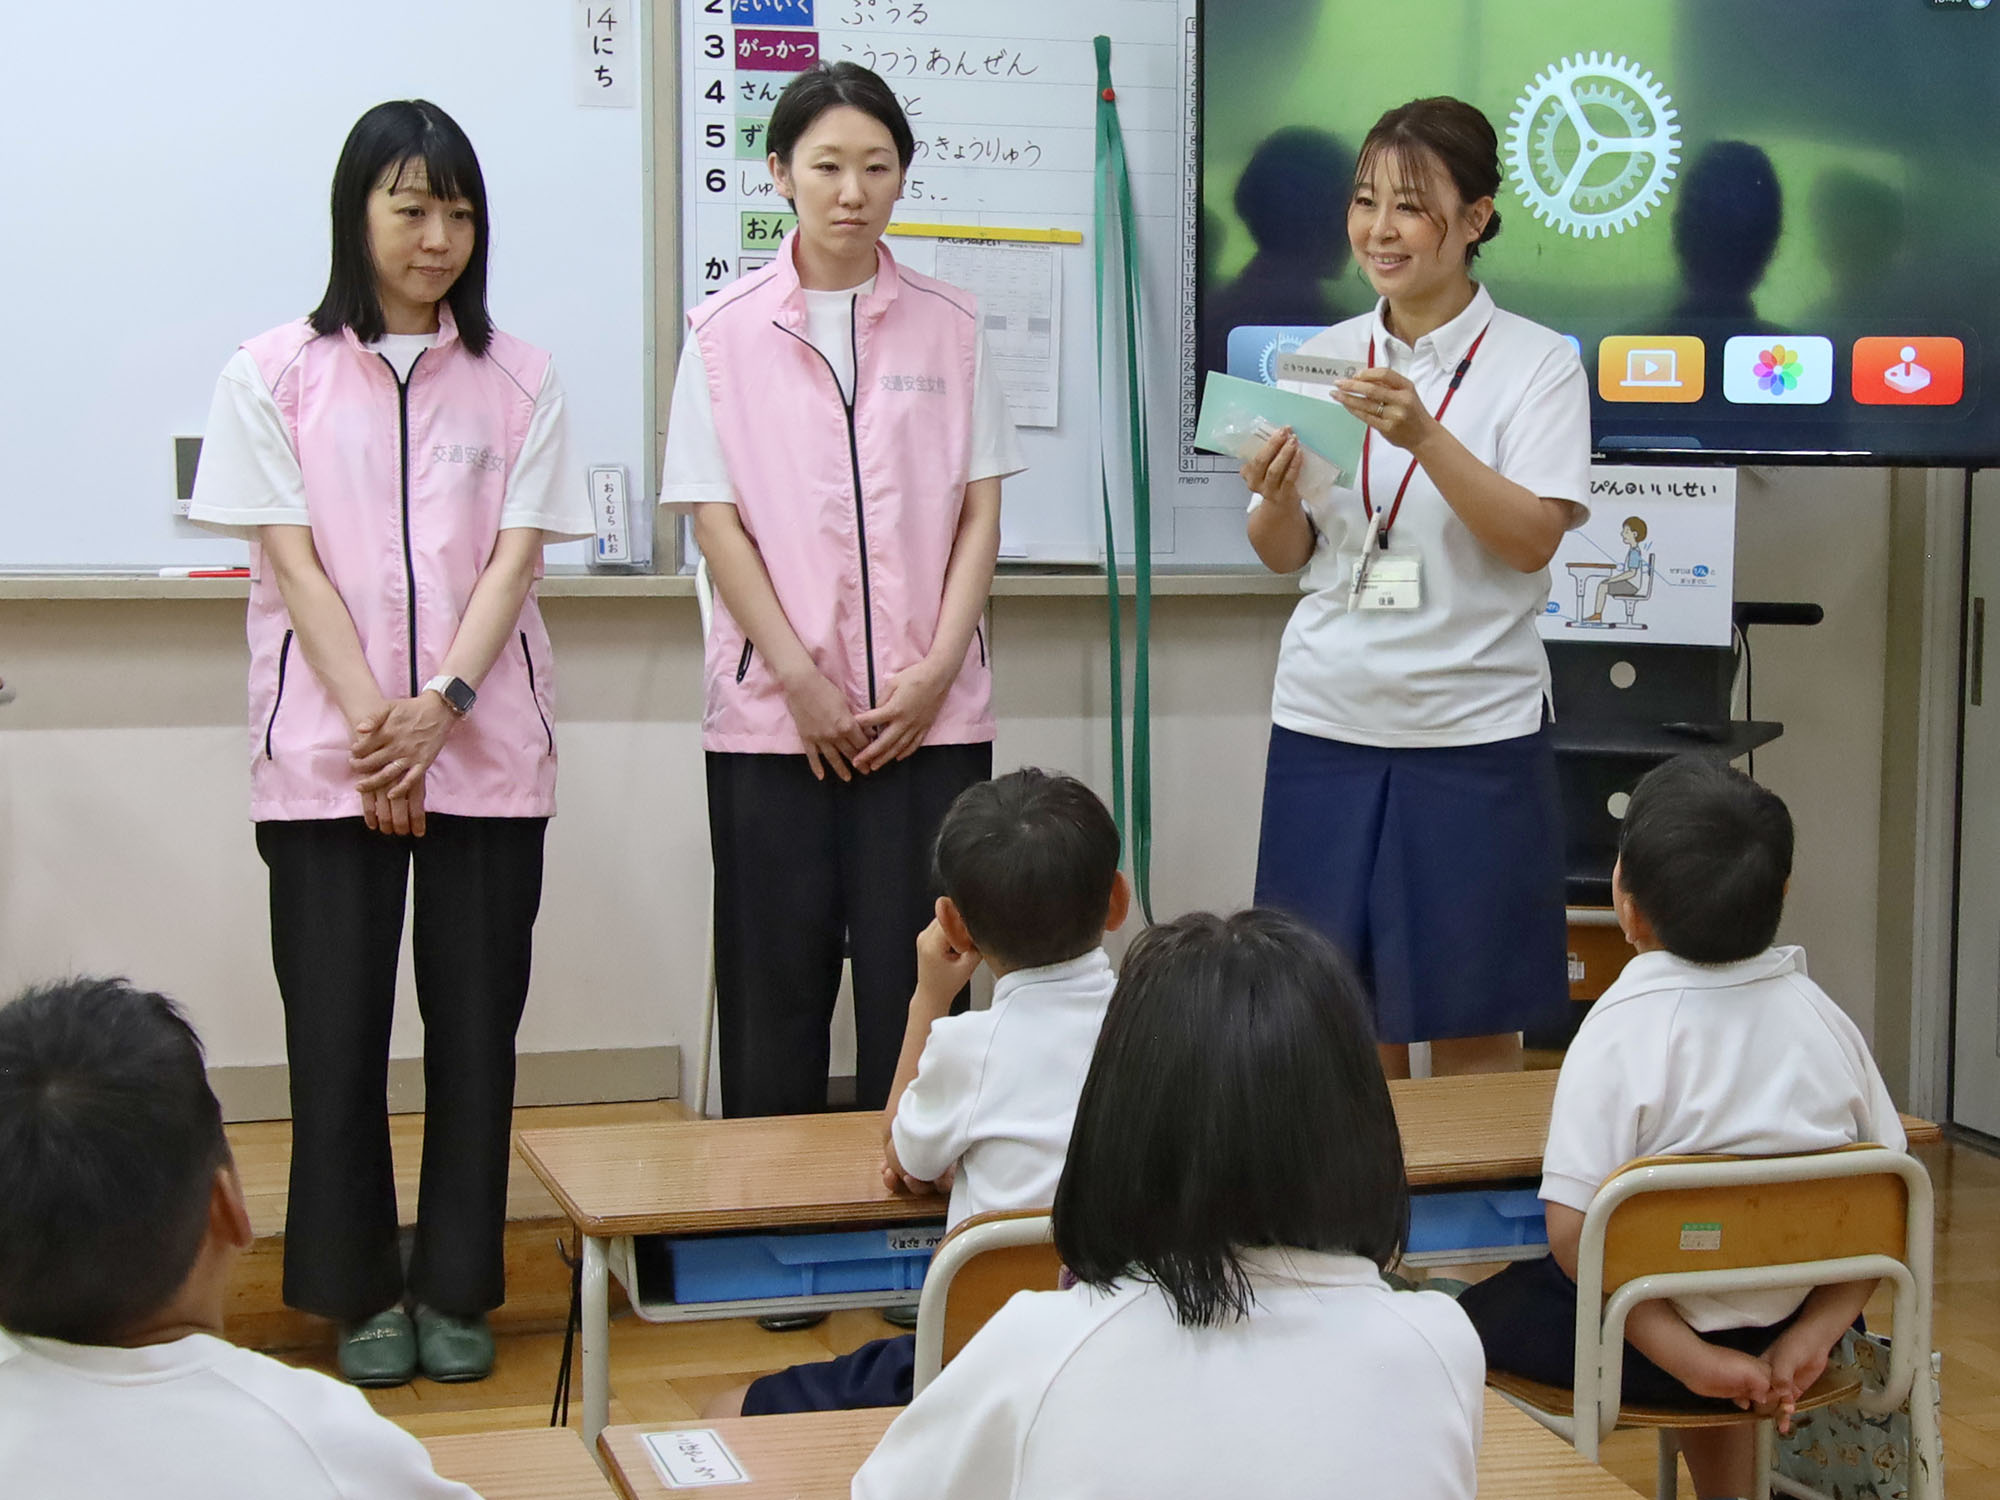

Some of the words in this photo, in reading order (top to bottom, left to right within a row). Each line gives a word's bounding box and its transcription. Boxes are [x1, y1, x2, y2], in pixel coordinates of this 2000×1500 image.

[704, 34, 725, 59] 3
[738, 38, 815, 59] がっかつ
[704, 79, 726, 104] 4
[740, 81, 787, 101] さん
[705, 124, 726, 148] 5
[705, 169, 727, 193] 6
[747, 217, 799, 240] おん
[1183, 390, 1196, 400] 26
[1183, 404, 1196, 414] 27
[1183, 418, 1196, 428] 28
[1182, 432, 1195, 442] 29
[1182, 445, 1196, 456] 30
[1182, 459, 1194, 470] 31
[1178, 475, 1210, 485] memo
[603, 482, 616, 527] おくむら
[607, 532, 619, 554] れお
